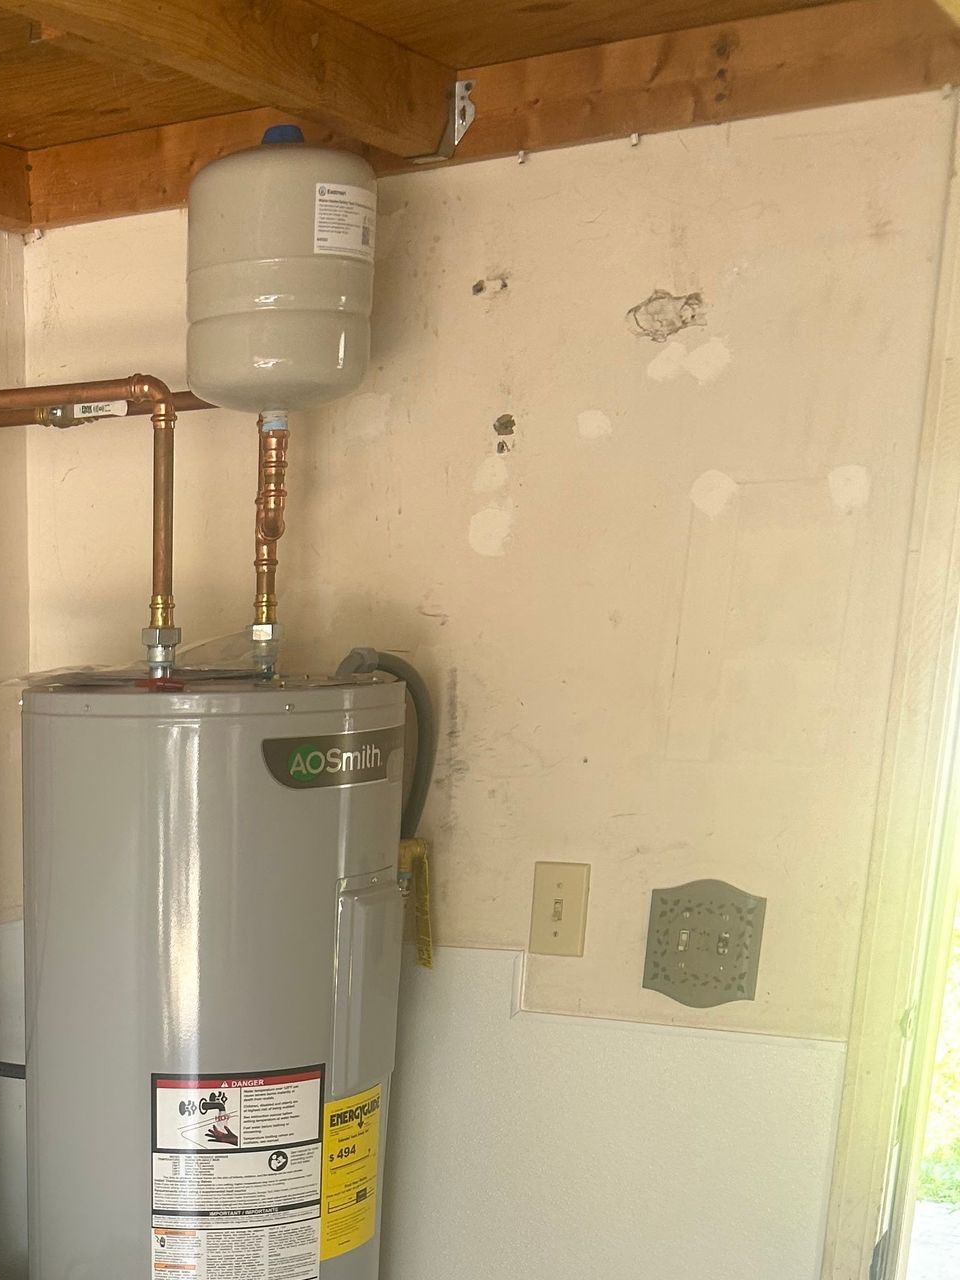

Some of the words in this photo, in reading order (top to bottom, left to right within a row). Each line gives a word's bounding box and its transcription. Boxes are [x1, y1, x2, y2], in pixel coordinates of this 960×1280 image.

[290, 744, 381, 775] AOSmith
[231, 1080, 264, 1088] DANGER
[337, 1144, 357, 1160] 494
